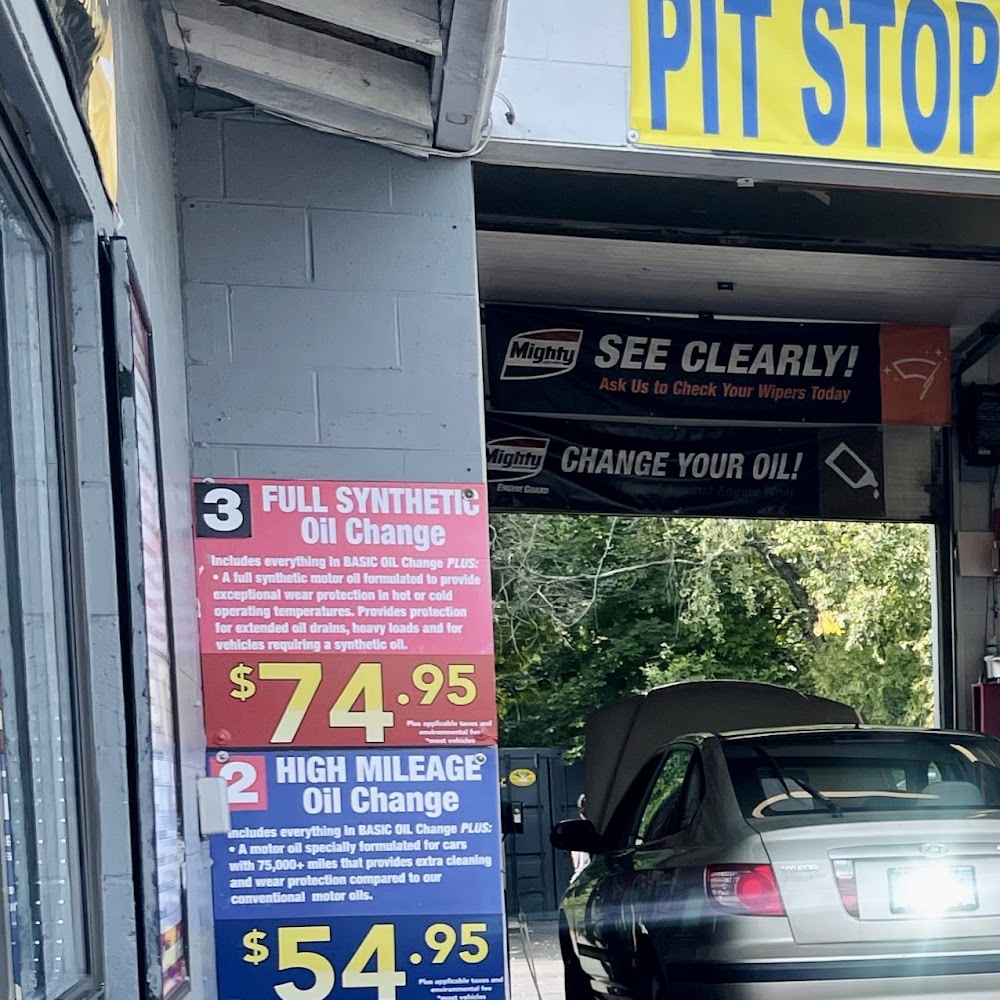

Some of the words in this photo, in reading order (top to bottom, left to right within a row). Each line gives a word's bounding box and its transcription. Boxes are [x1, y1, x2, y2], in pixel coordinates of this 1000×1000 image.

[647, 0, 772, 138] PIT
[801, 0, 1000, 155] STOP
[509, 341, 575, 365] Mighty
[594, 334, 672, 370] SEE
[681, 340, 860, 377] CLEARLY!
[599, 377, 626, 393] Ask
[631, 378, 649, 395] Us
[654, 380, 668, 395] to
[672, 380, 717, 397] Check
[723, 383, 754, 398] Your
[758, 384, 805, 402] Wipers
[811, 385, 851, 404] Today
[561, 446, 669, 476] CHANGE
[677, 452, 743, 480] YOUR
[752, 452, 803, 480] OIL!
[203, 488, 244, 532] 3
[262, 485, 328, 513] FULL
[336, 486, 480, 516] SYNTHETIC
[301, 517, 336, 545] Oil
[345, 518, 446, 551] Change
[211, 555, 261, 567] Includes
[264, 556, 326, 570] everything
[329, 556, 340, 567] in
[344, 556, 378, 567] BASIC
[381, 557, 399, 568] OIL
[401, 557, 443, 570] Change
[447, 558, 479, 569] PLUS:
[222, 572, 231, 583] A
[233, 572, 252, 583] full
[255, 572, 308, 586] synthetic
[311, 573, 344, 584] motor
[346, 573, 361, 584] oil
[363, 573, 423, 585] formulated
[426, 575, 438, 585] to
[440, 574, 481, 587] provide
[213, 589, 281, 602] exceptional
[284, 591, 314, 600] wear
[316, 590, 375, 602] protection
[378, 590, 389, 600] in
[392, 590, 411, 601] hot
[414, 592, 426, 601] or
[429, 590, 453, 601] cold
[214, 606, 271, 619] operating
[273, 606, 354, 619] temperatures.
[358, 606, 407, 617] Provides
[410, 607, 467, 619] protection
[215, 622, 232, 633] for
[235, 622, 289, 633] extended
[292, 622, 307, 633] oil
[310, 622, 350, 635] drains,
[352, 622, 386, 635] heavy
[389, 622, 420, 633] loads
[423, 622, 444, 633] and
[447, 622, 463, 633] for
[216, 639, 265, 650] vehicles
[267, 639, 321, 652] requiring
[324, 641, 331, 650] a
[334, 639, 387, 652] synthetic
[390, 639, 408, 650] oil.
[229, 662, 477, 743] $74.95
[276, 755, 347, 783] HIGH
[356, 754, 482, 783] MILEAGE
[219, 761, 259, 804] 2
[303, 787, 341, 815] Oil
[350, 787, 459, 817] Change
[280, 825, 341, 839] everything
[343, 825, 355, 836] in
[358, 824, 392, 835] BASIC
[395, 823, 413, 834] OIL
[416, 823, 457, 836] Change
[461, 822, 493, 833] PLUS:
[238, 844, 248, 855] A
[250, 843, 284, 854] motor
[287, 842, 302, 853] oil
[305, 841, 356, 855] specially
[359, 840, 420, 852] formulated
[424, 839, 440, 850] for
[443, 841, 467, 850] cars
[229, 860, 255, 871] with
[257, 859, 304, 872] 75,000+
[307, 858, 338, 869] miles
[340, 858, 363, 868] that
[366, 856, 413, 870] provides
[415, 856, 443, 866] extra
[446, 855, 492, 867] cleaning
[230, 876, 252, 888] and
[254, 878, 285, 887] wear
[288, 875, 346, 889] protection
[349, 872, 406, 886] compared
[408, 872, 420, 883] to
[423, 873, 442, 882] our
[230, 892, 305, 904] conventional
[312, 891, 346, 902] motor
[349, 890, 373, 901] oils.
